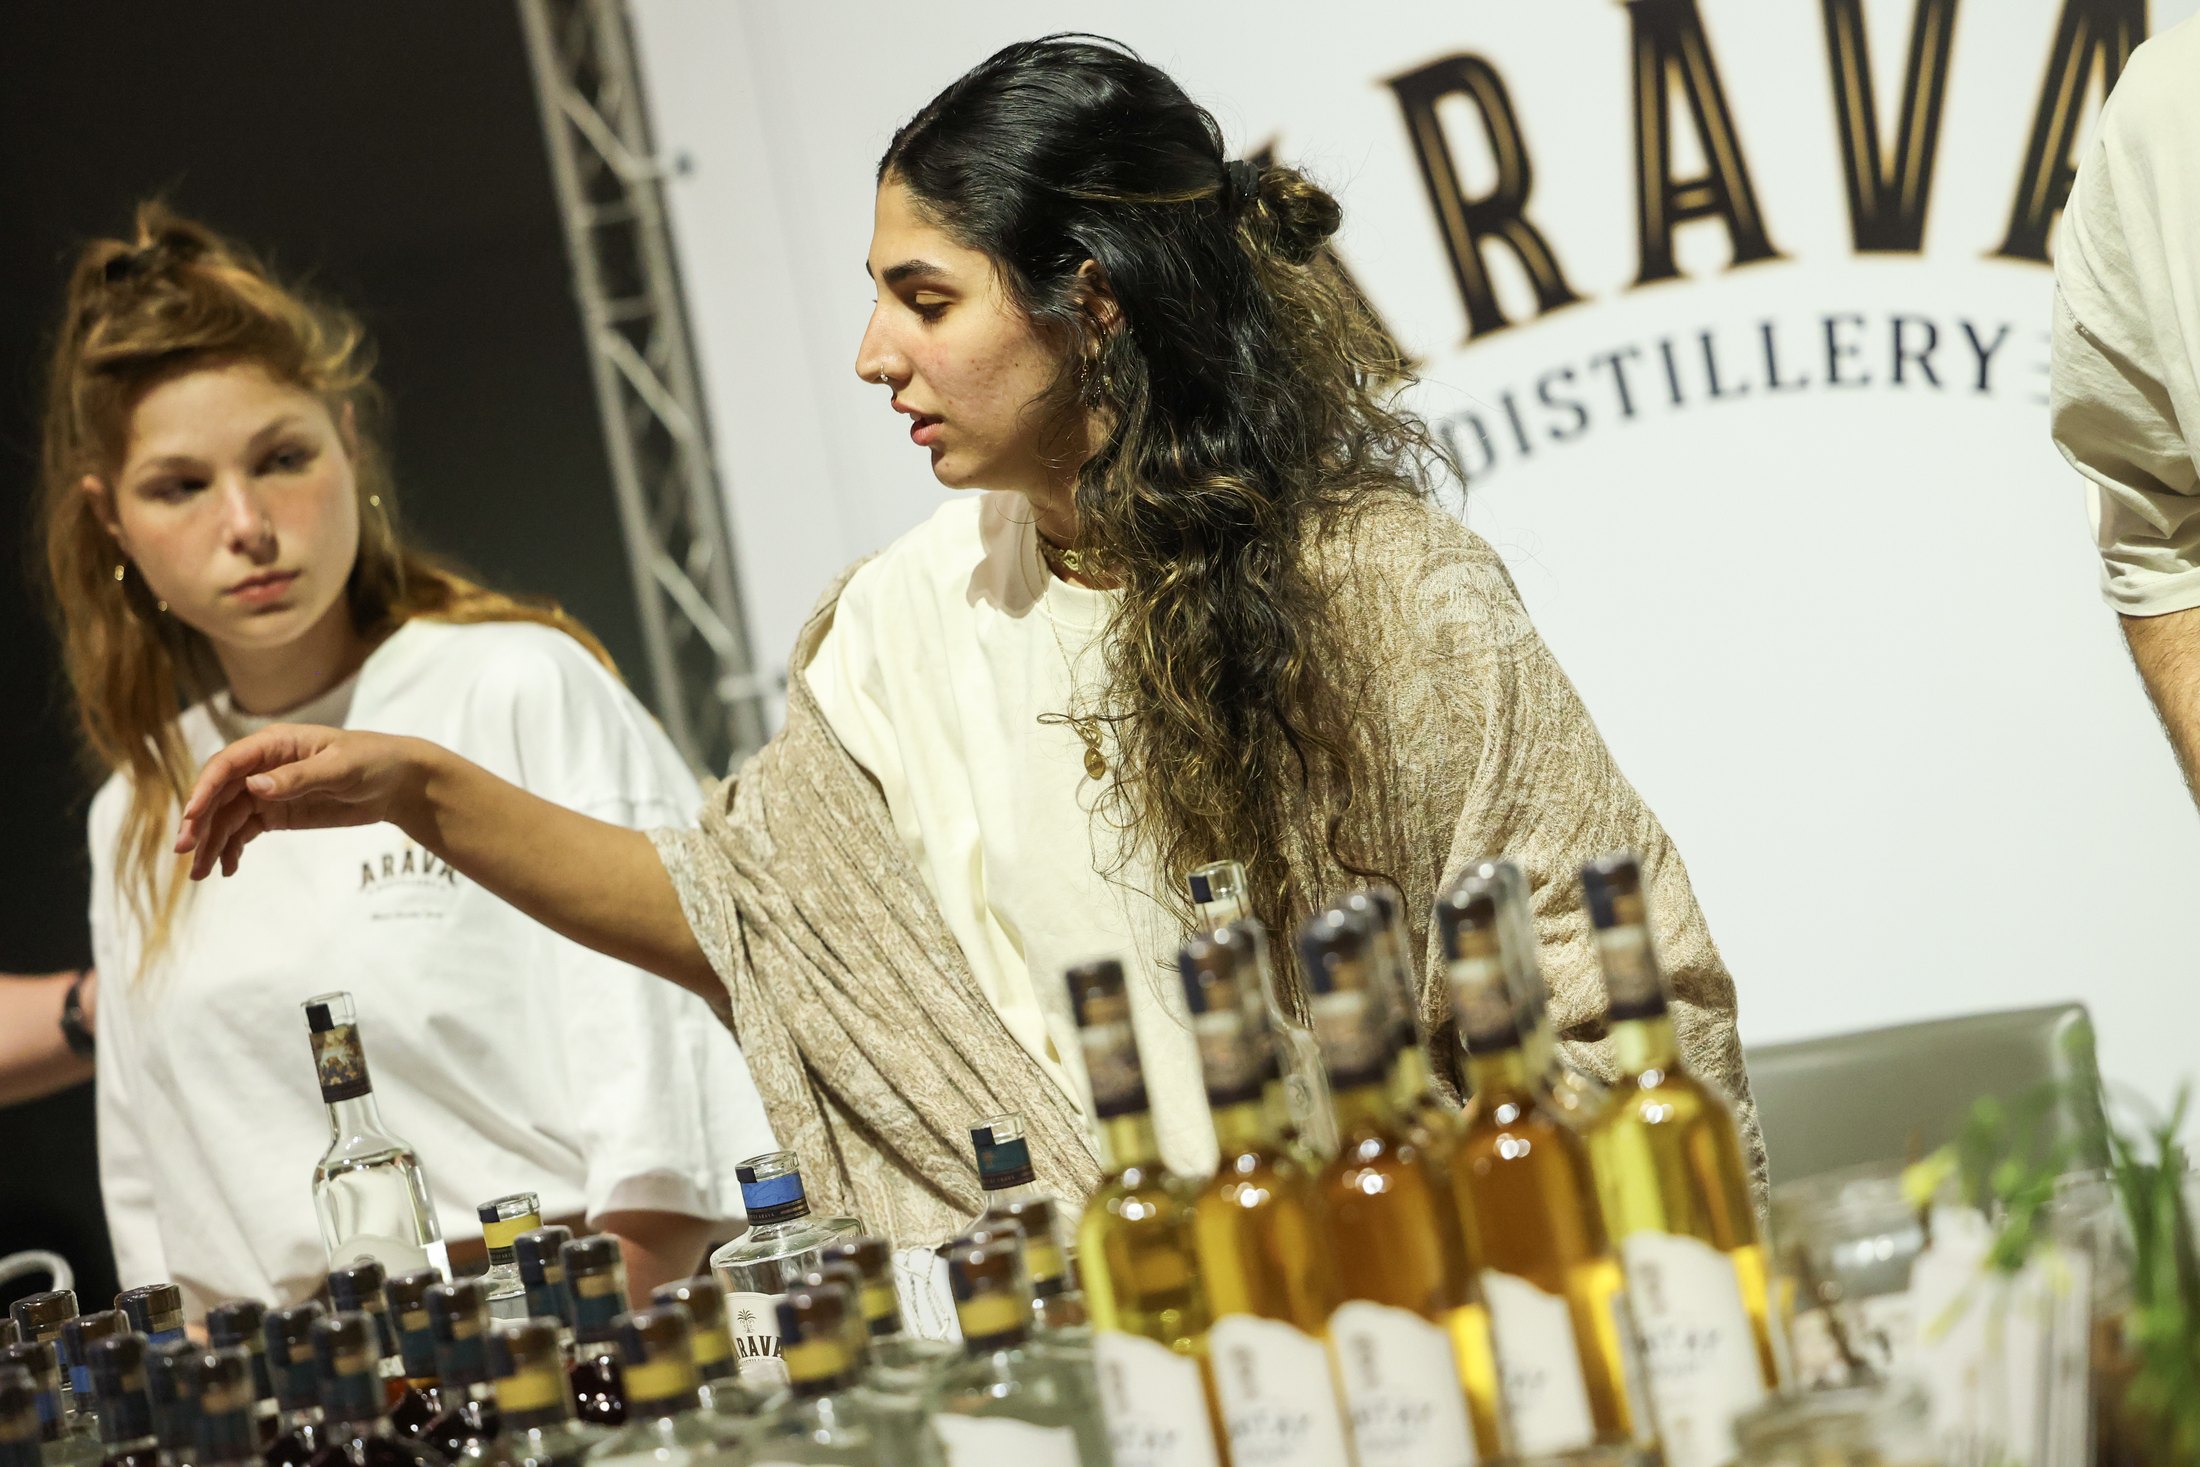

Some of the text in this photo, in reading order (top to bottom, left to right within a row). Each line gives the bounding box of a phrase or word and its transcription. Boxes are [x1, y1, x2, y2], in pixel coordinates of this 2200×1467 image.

[1245, 0, 2148, 368] RAVA
[1436, 312, 2013, 485] DISTILLERY
[360, 848, 457, 890] ARAVA
[736, 1335, 785, 1360] RAVA
